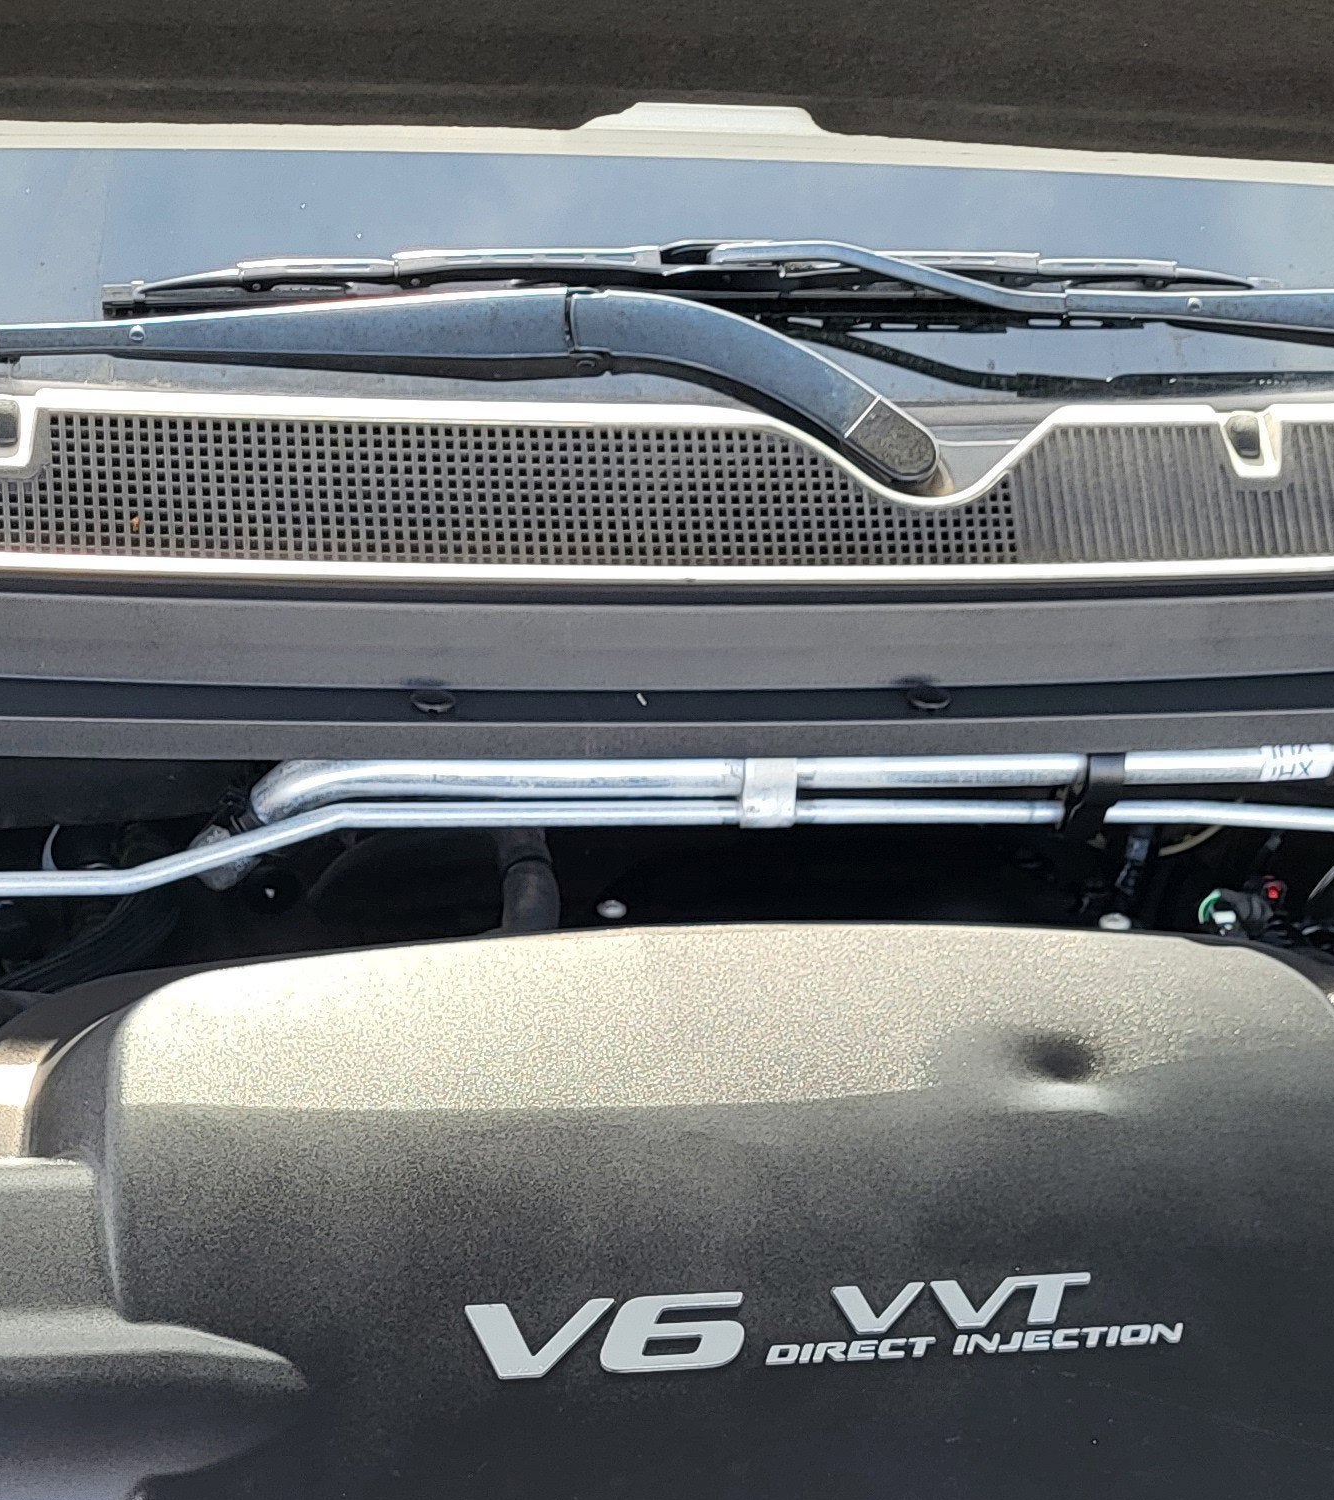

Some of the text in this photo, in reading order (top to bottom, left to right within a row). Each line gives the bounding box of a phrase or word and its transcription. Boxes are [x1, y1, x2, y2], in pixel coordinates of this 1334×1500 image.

[464, 1291, 745, 1380] V6
[830, 1272, 1092, 1336] VVT
[764, 1322, 1186, 1367] DIRECT INJECTION
